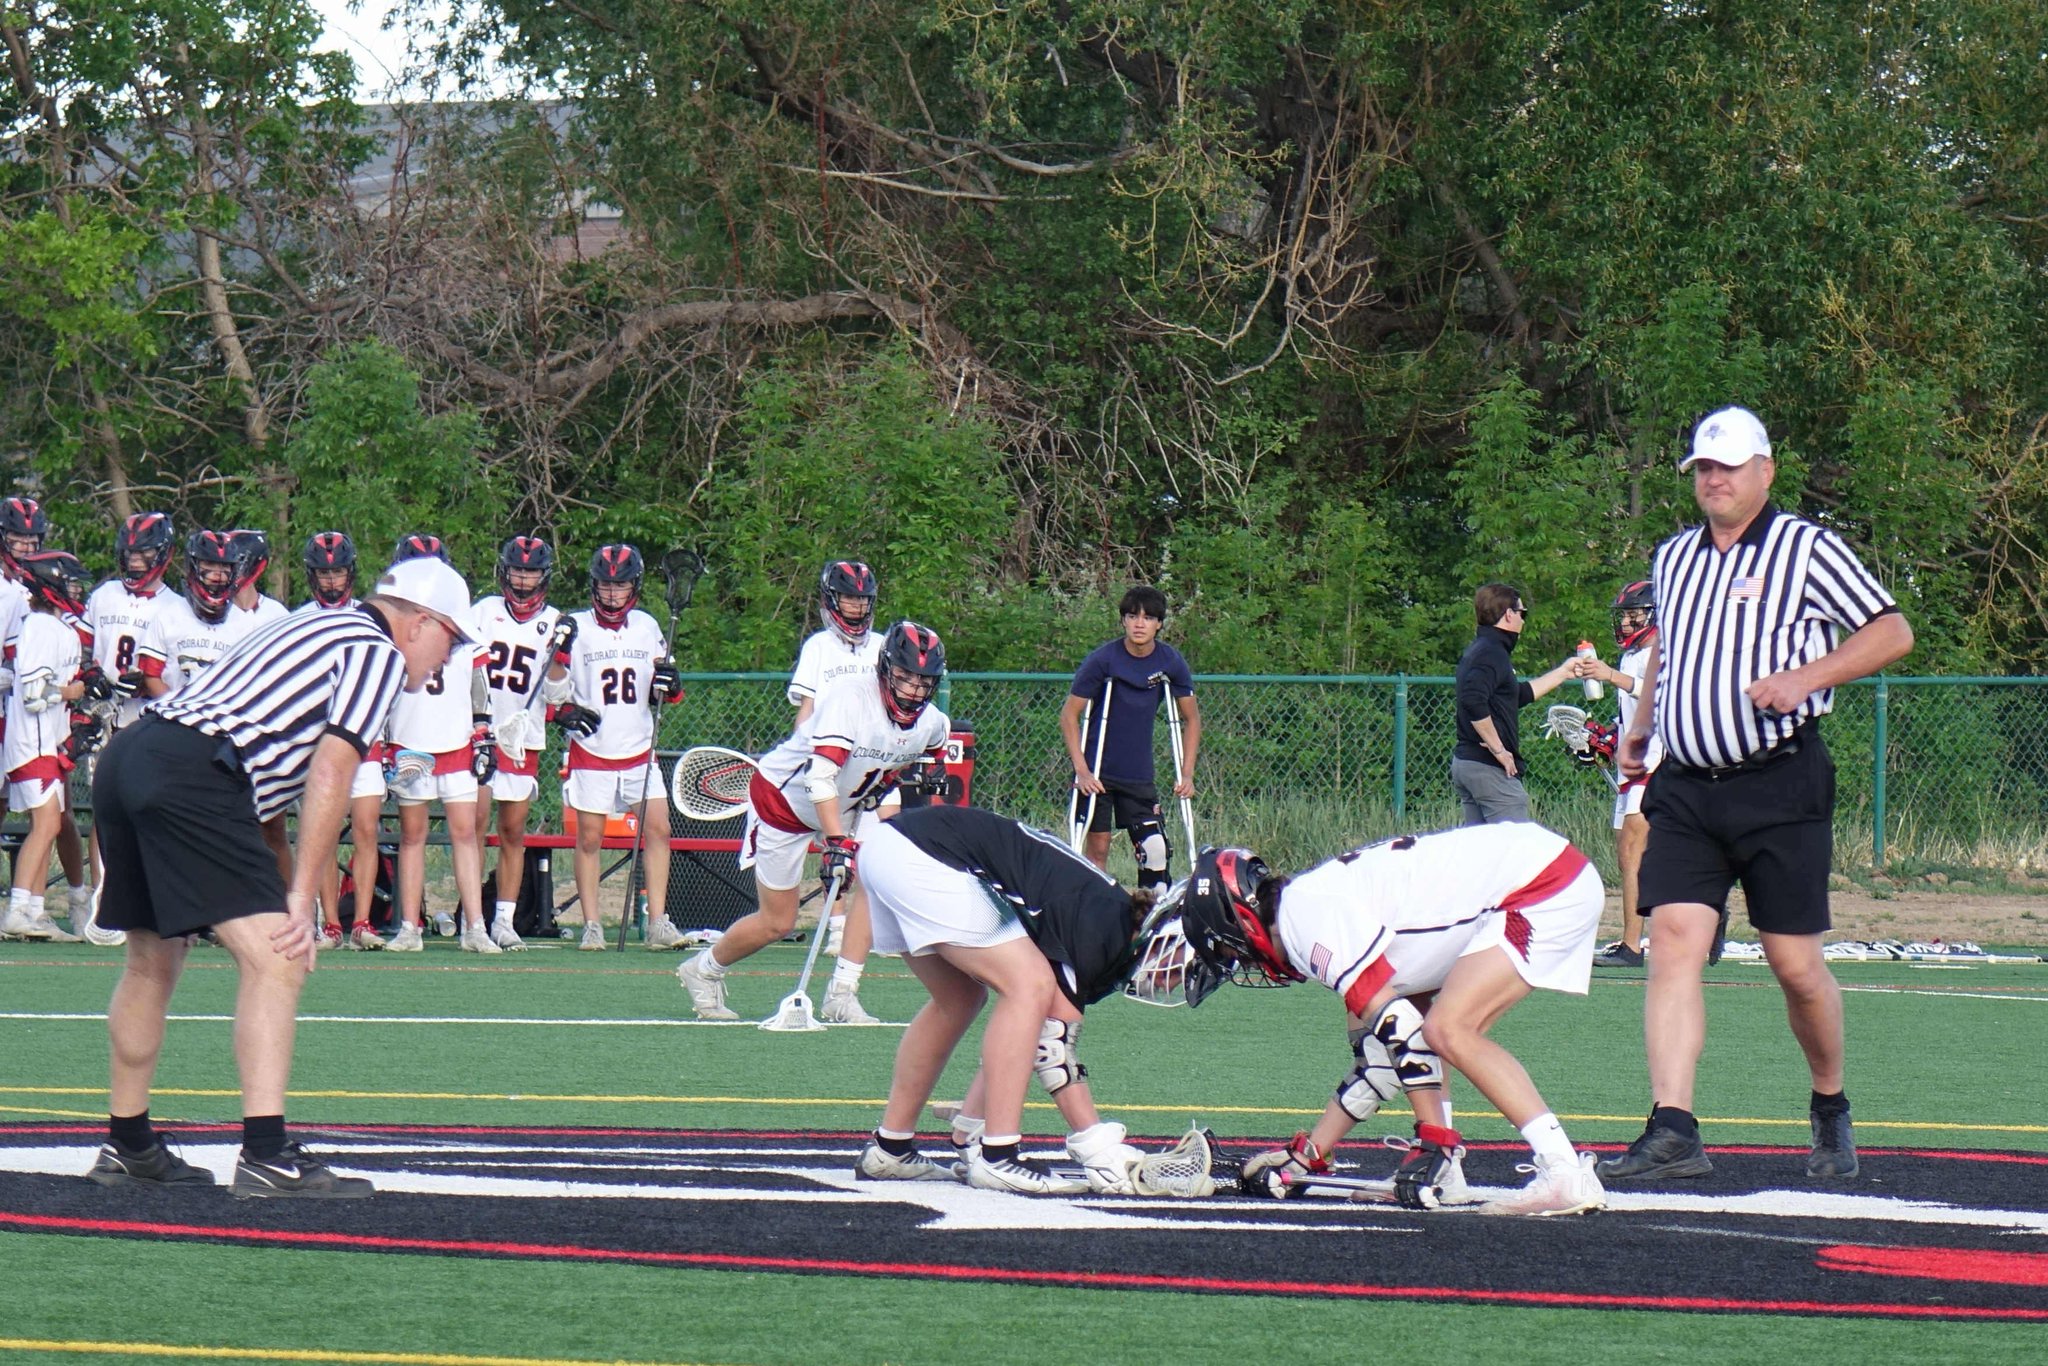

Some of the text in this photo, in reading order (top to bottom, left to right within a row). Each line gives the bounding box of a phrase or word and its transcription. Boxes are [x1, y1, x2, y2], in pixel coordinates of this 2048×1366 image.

[116, 634, 136, 672] 8
[486, 640, 538, 695] 25
[583, 649, 649, 666] COLORADO ACADEMY
[600, 667, 638, 706] 26
[1197, 878, 1211, 896] 35
